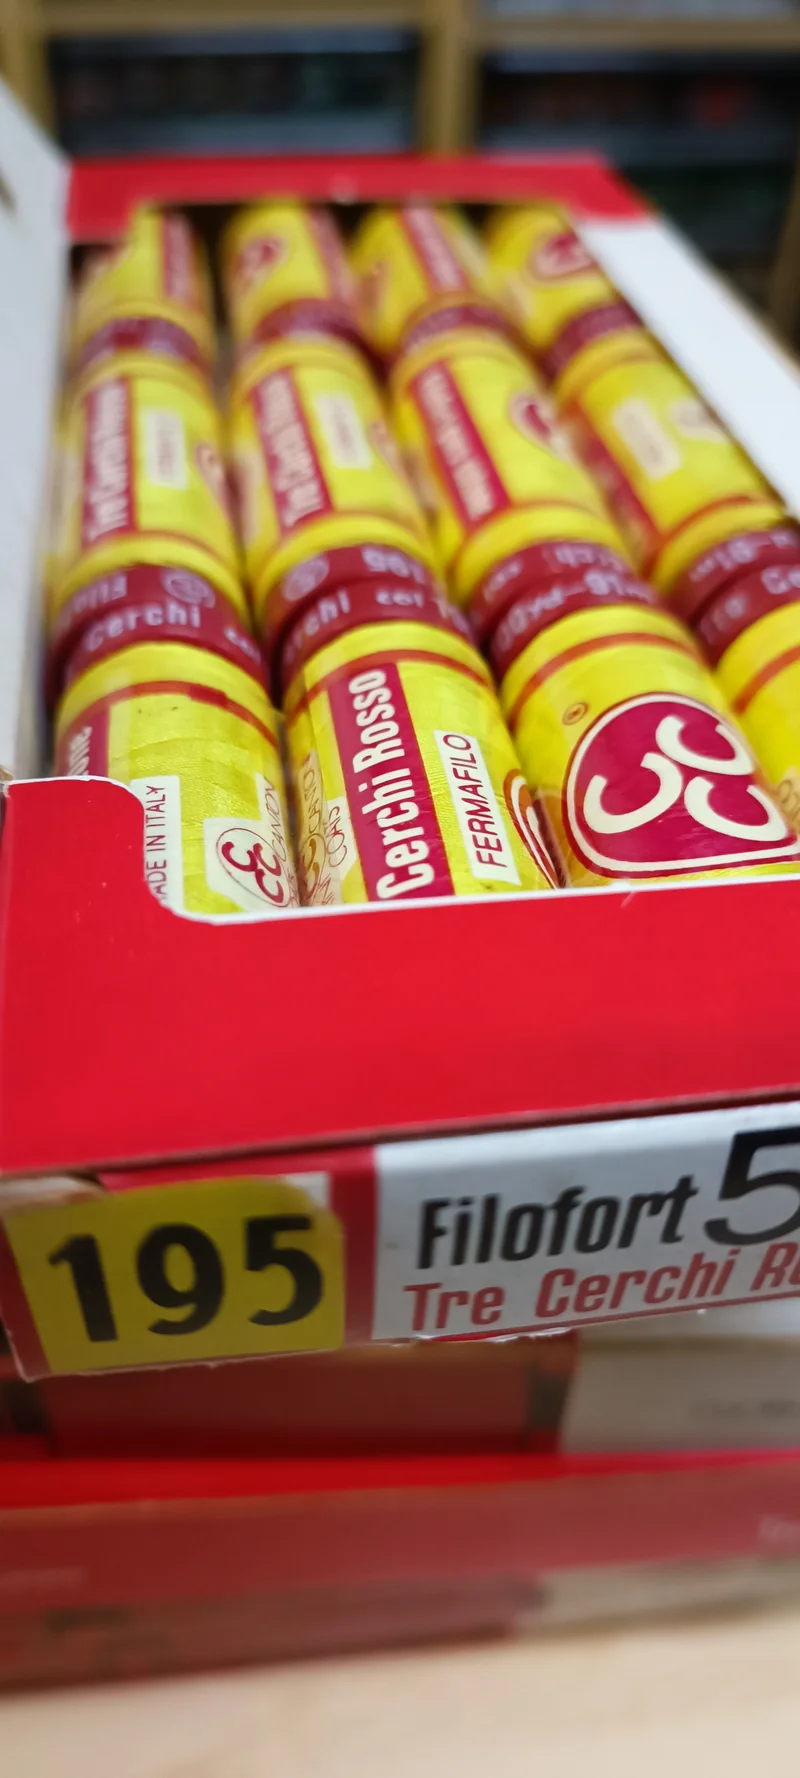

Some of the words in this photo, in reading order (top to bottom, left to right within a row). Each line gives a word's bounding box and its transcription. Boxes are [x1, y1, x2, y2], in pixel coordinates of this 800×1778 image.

[348, 669, 407, 774] Rosso
[146, 785, 166, 828] ITALY
[146, 834, 167, 853] IN
[359, 767, 436, 900] Cerchi
[442, 734, 508, 868] FERMAFILO
[146, 859, 168, 899] ADE
[417, 1175, 698, 1270] Filofort
[47, 1214, 324, 1343] 195
[404, 1283, 506, 1331] Tre
[535, 1248, 741, 1318] Cerchi
